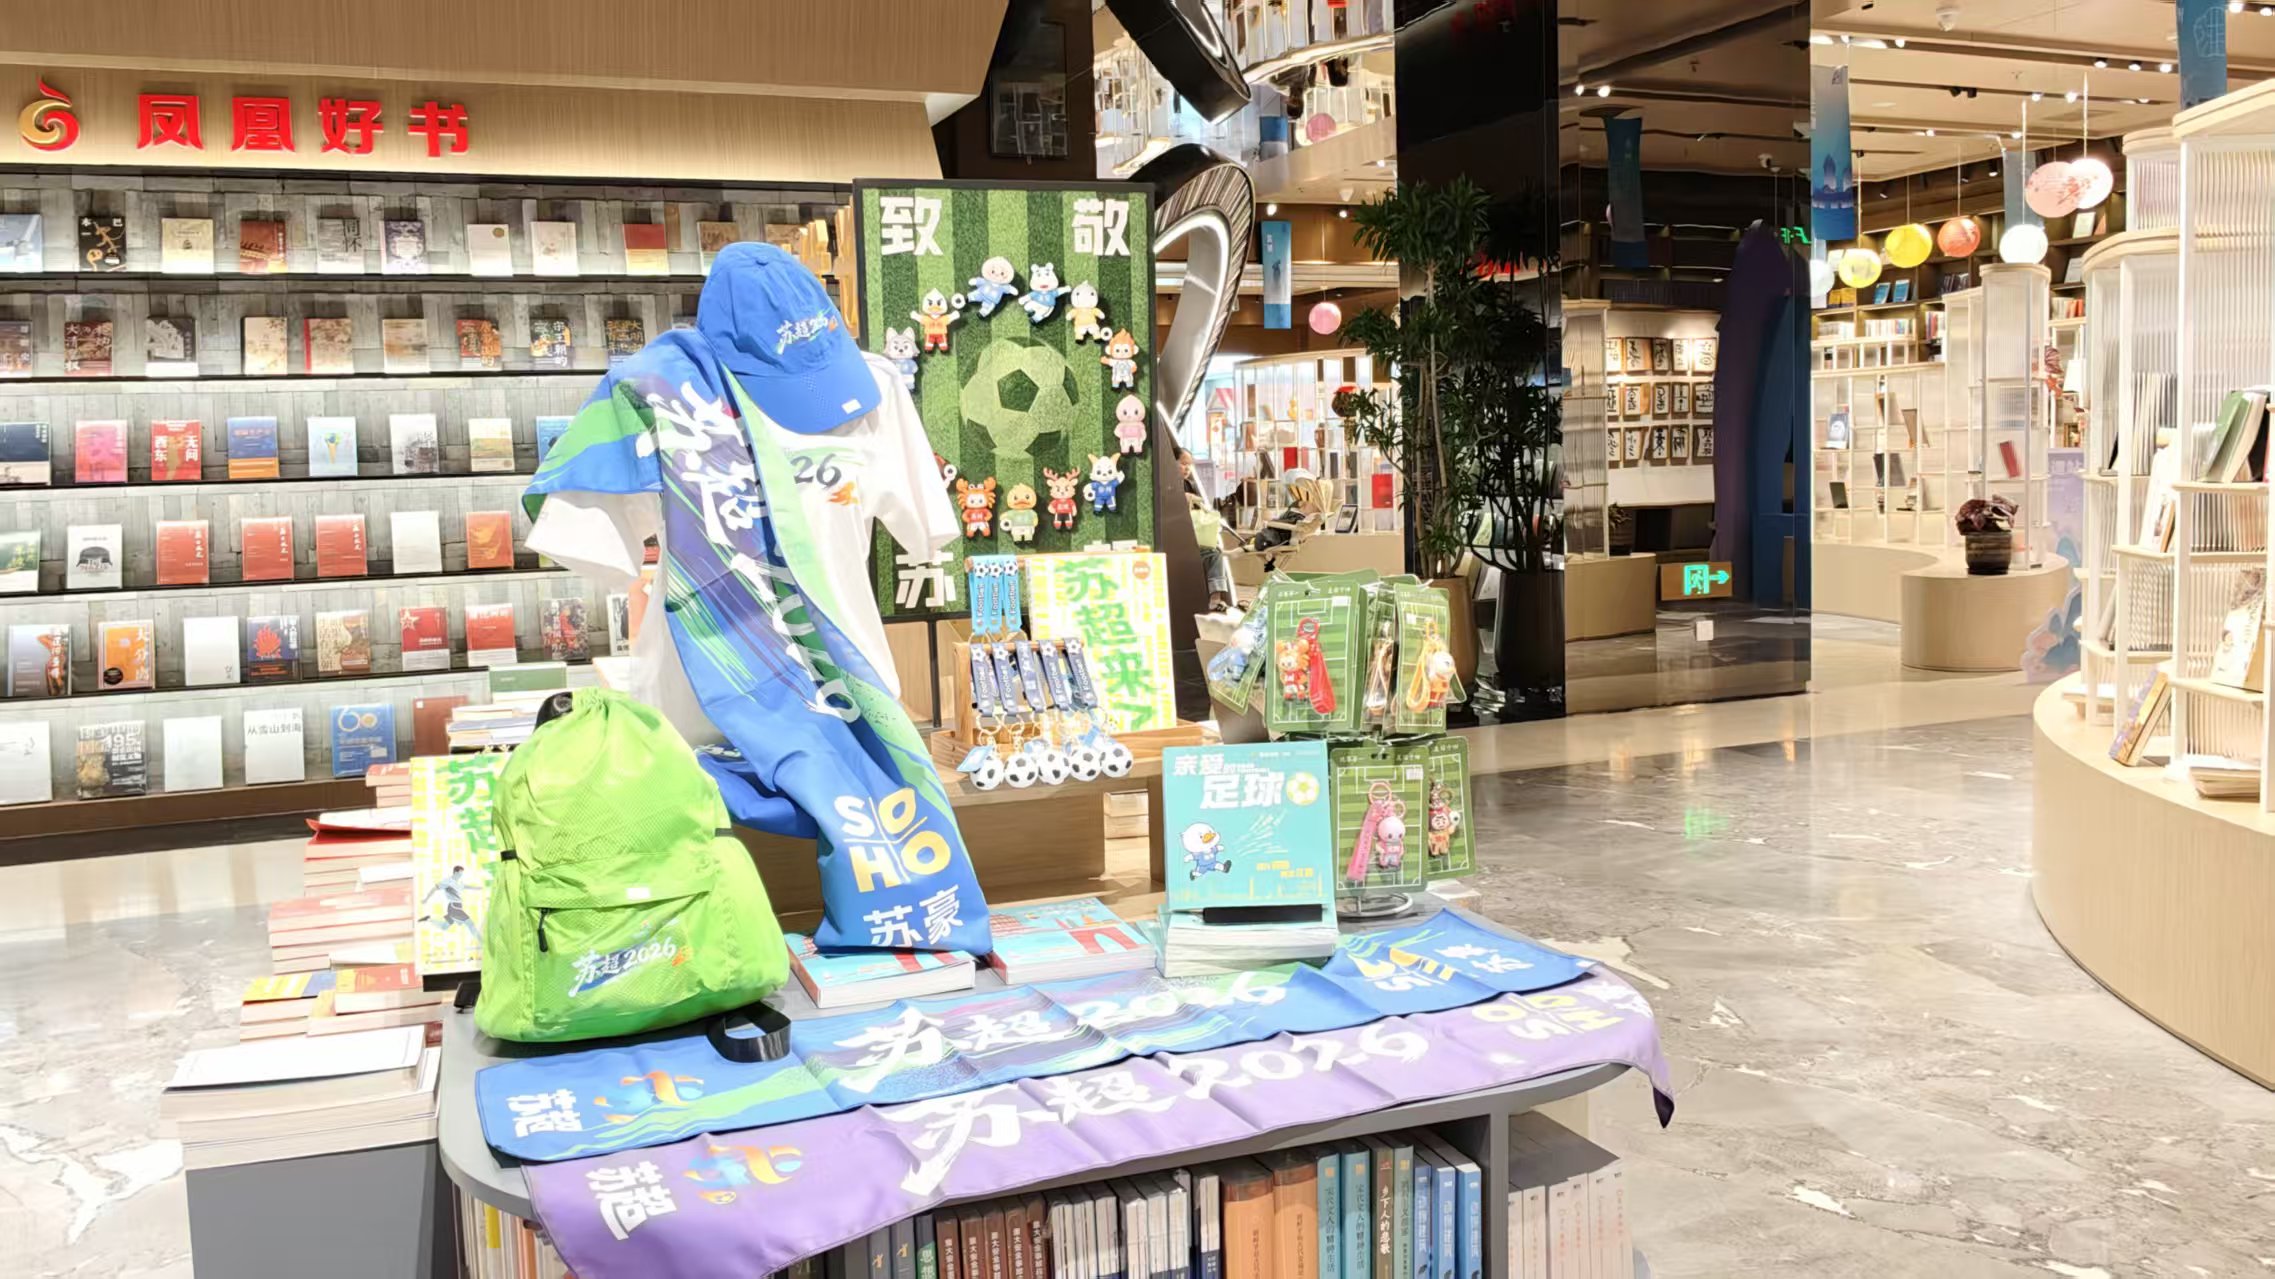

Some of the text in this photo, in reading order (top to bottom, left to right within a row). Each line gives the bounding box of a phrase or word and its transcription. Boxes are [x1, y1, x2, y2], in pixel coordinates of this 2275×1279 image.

[136, 94, 469, 158] 凤凰好书
[880, 196, 944, 256] 致
[1072, 197, 1131, 257] 敬
[895, 550, 957, 609] 苏
[1053, 556, 1158, 732] 苏超来了
[1200, 771, 1284, 810] 足球
[863, 884, 964, 948] 苏豪
[1379, 1185, 1392, 1255] 乡下人的悲歌
